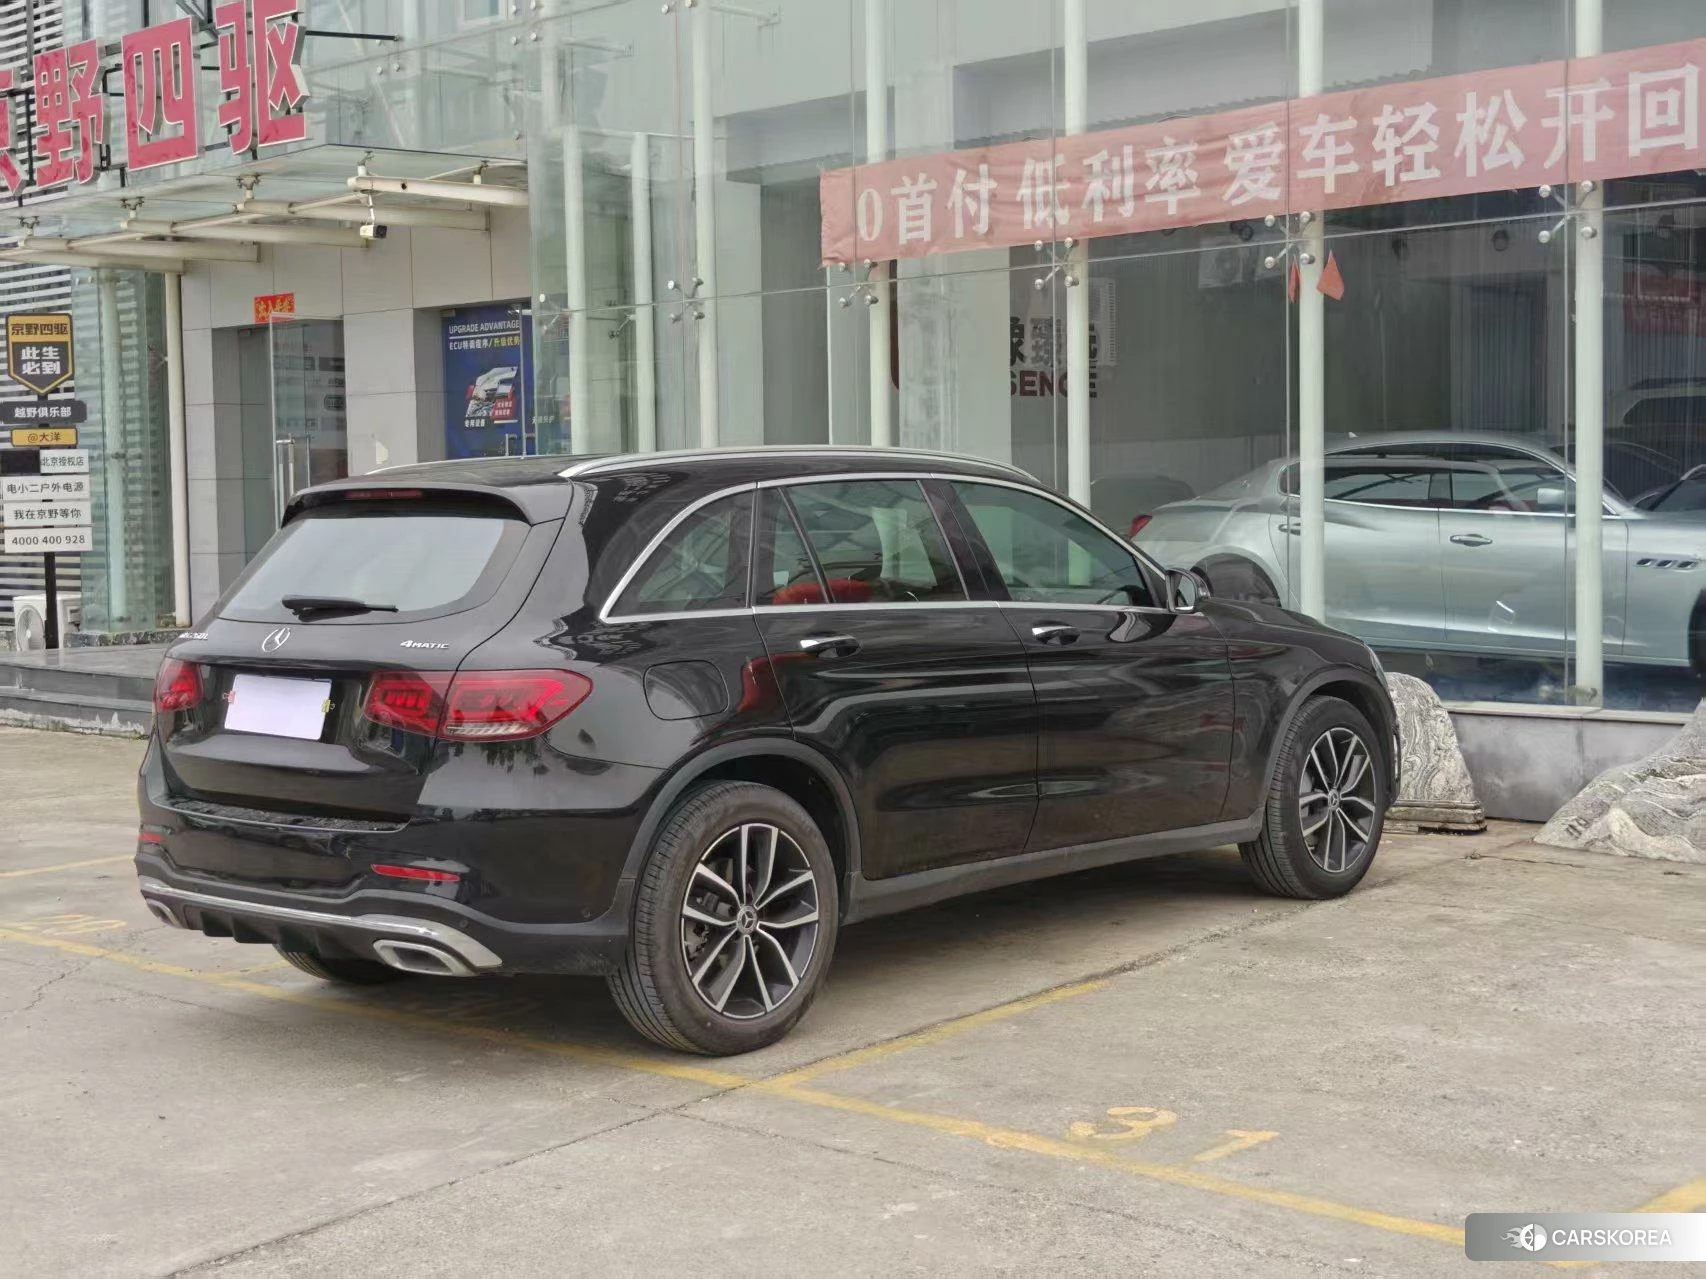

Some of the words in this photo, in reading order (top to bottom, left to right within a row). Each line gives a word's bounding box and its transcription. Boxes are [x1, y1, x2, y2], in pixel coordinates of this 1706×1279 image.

[0, 0, 307, 193] 野四驱
[11, 323, 69, 336] 京野四驱
[449, 322, 479, 334] UPGRADE
[479, 320, 520, 332] ADVANTAGE
[21, 346, 60, 360] 此生
[22, 361, 61, 375] 必到
[14, 406, 72, 418] 越野俱乐部
[41, 457, 84, 466] 北京授权店
[7, 482, 84, 494] 电小二户外电源
[14, 508, 82, 520] 我在京野等你
[12, 536, 39, 546] 4000
[42, 535, 62, 545] 400
[65, 534, 85, 544] 928
[400, 640, 449, 649] 4MATIC
